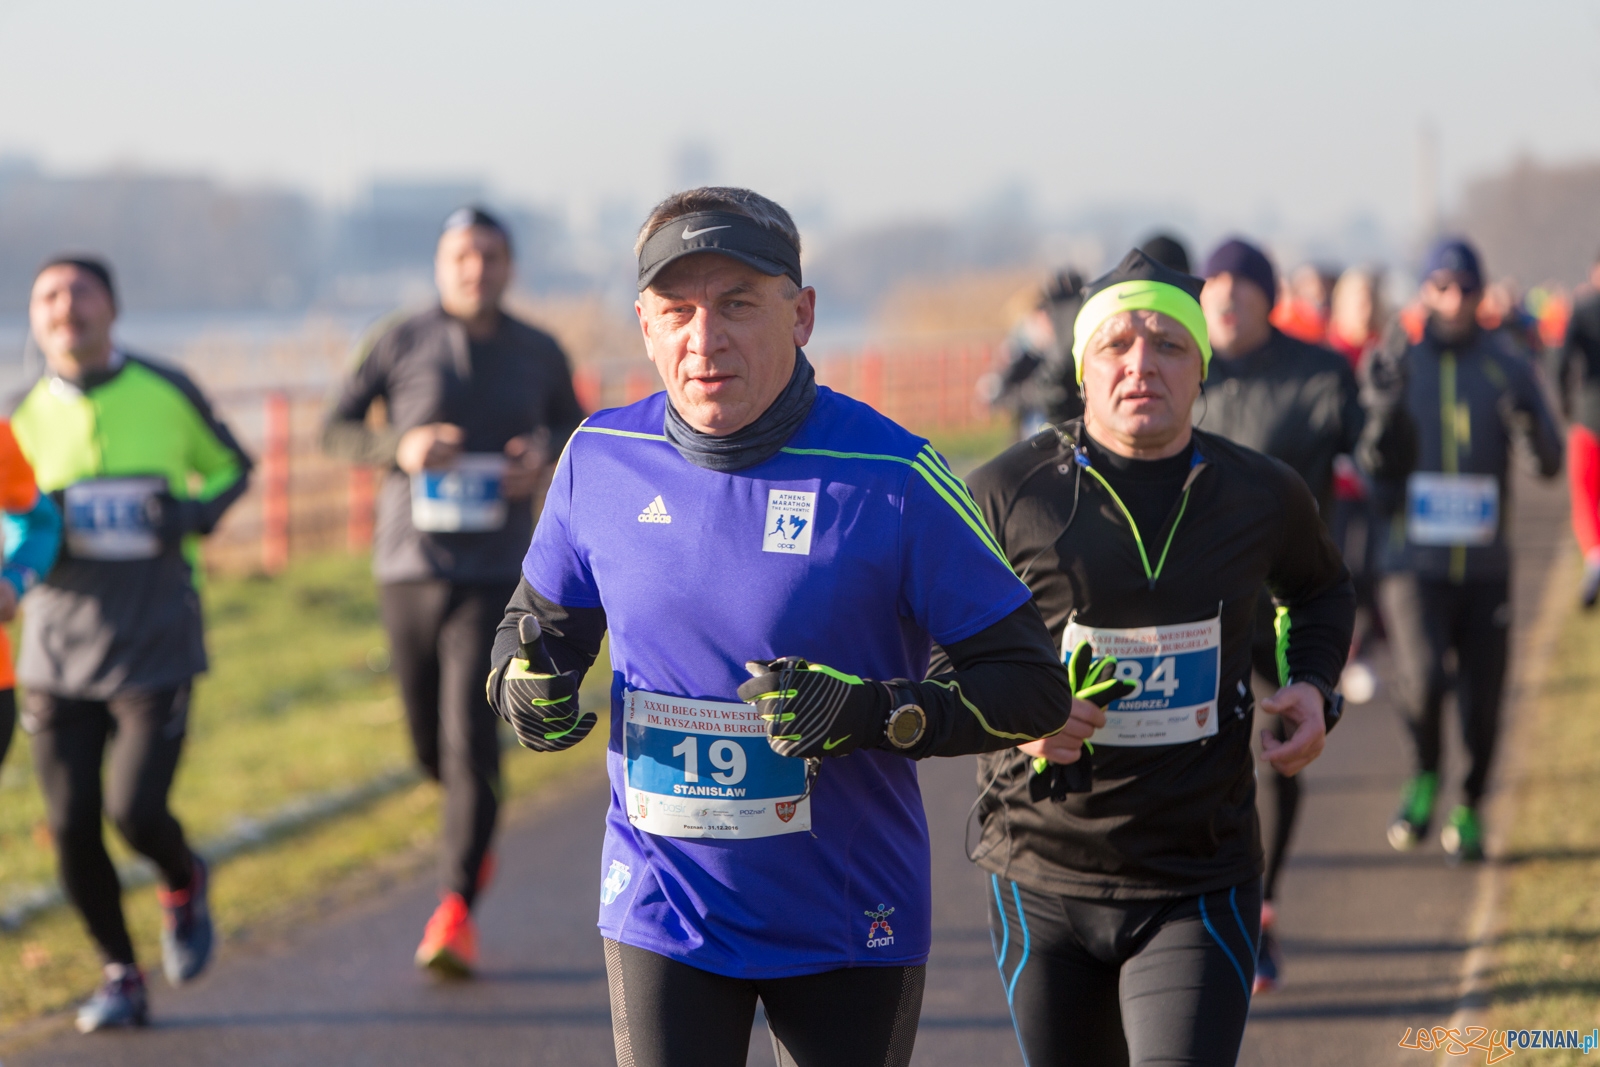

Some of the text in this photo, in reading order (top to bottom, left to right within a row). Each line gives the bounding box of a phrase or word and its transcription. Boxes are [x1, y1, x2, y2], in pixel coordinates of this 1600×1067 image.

[638, 512, 672, 524] adidas
[1114, 656, 1180, 700] 84
[644, 700, 764, 721] XXXII BIEG SYLWESTR
[1117, 698, 1170, 711] ANDRZEJ
[647, 714, 662, 725] IM.
[664, 717, 721, 731] RYSZARDA
[672, 736, 747, 786] 19
[673, 784, 747, 797] STANISLAW
